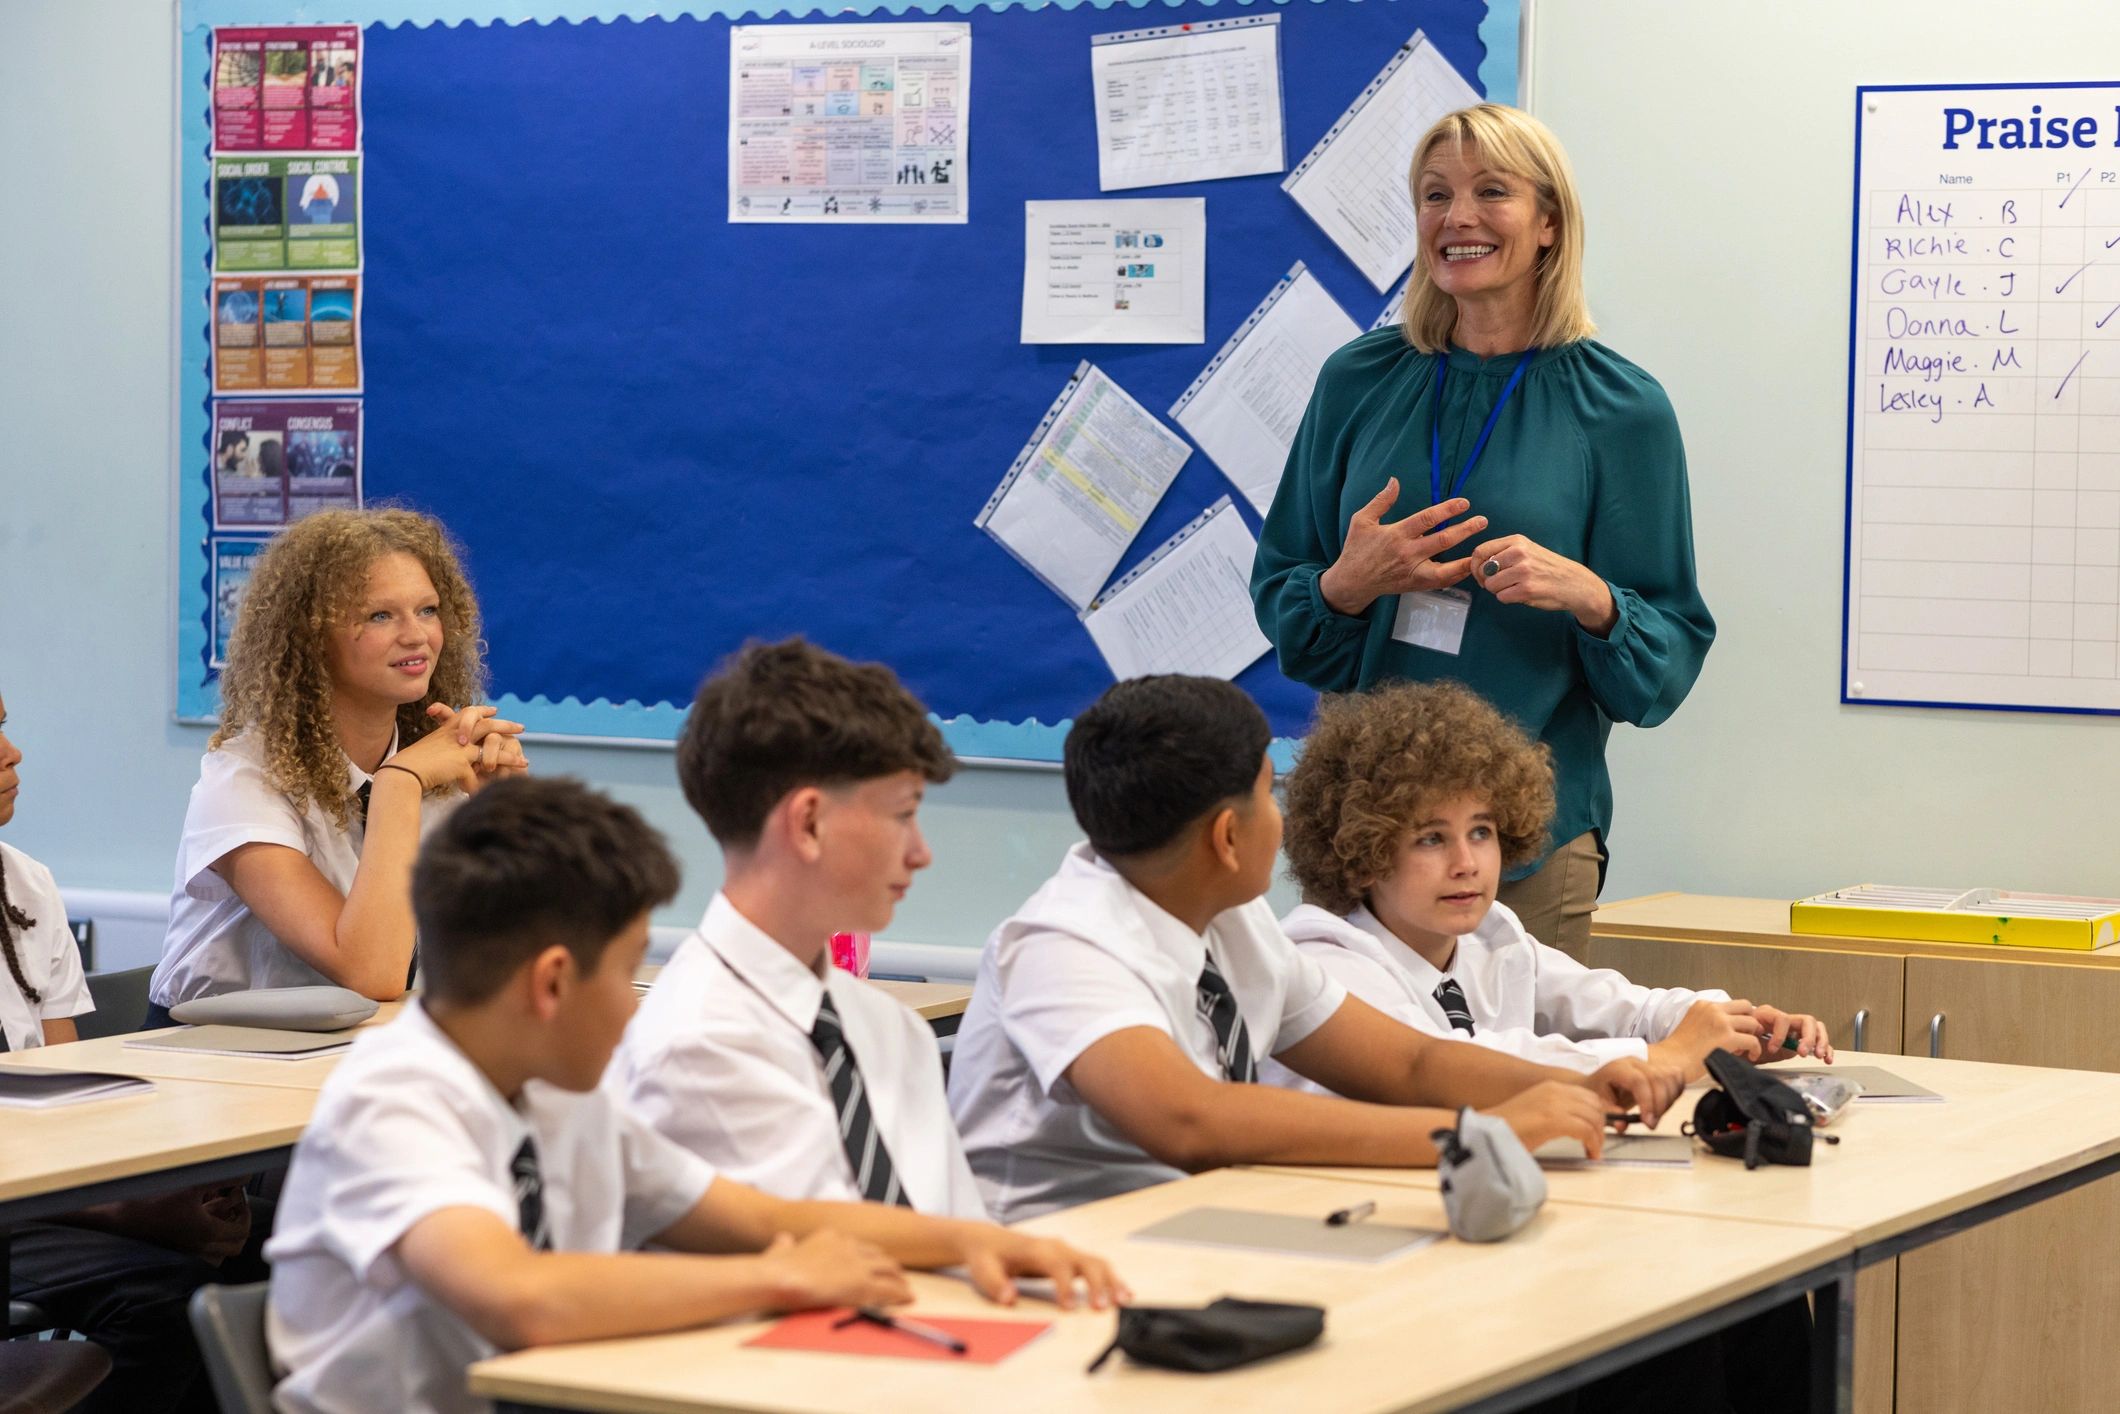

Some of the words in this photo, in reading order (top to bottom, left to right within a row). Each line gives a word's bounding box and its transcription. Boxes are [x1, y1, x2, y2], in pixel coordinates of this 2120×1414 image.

[1943, 105, 2098, 149] Praise
[1939, 174, 1973, 184] Name
[2057, 172, 2071, 183] P1
[2101, 172, 2116, 183] P2
[2002, 200, 2017, 224] B
[1999, 237, 2015, 258] C
[1880, 268, 1967, 300] Gayle
[2000, 272, 2016, 297] J
[1887, 307, 1980, 340] Donna
[2000, 309, 2019, 334] L
[1992, 347, 2022, 371] M
[1974, 383, 1995, 408] A
[218, 416, 253, 431] CONFLICT
[287, 416, 334, 431] CONSENSUS
